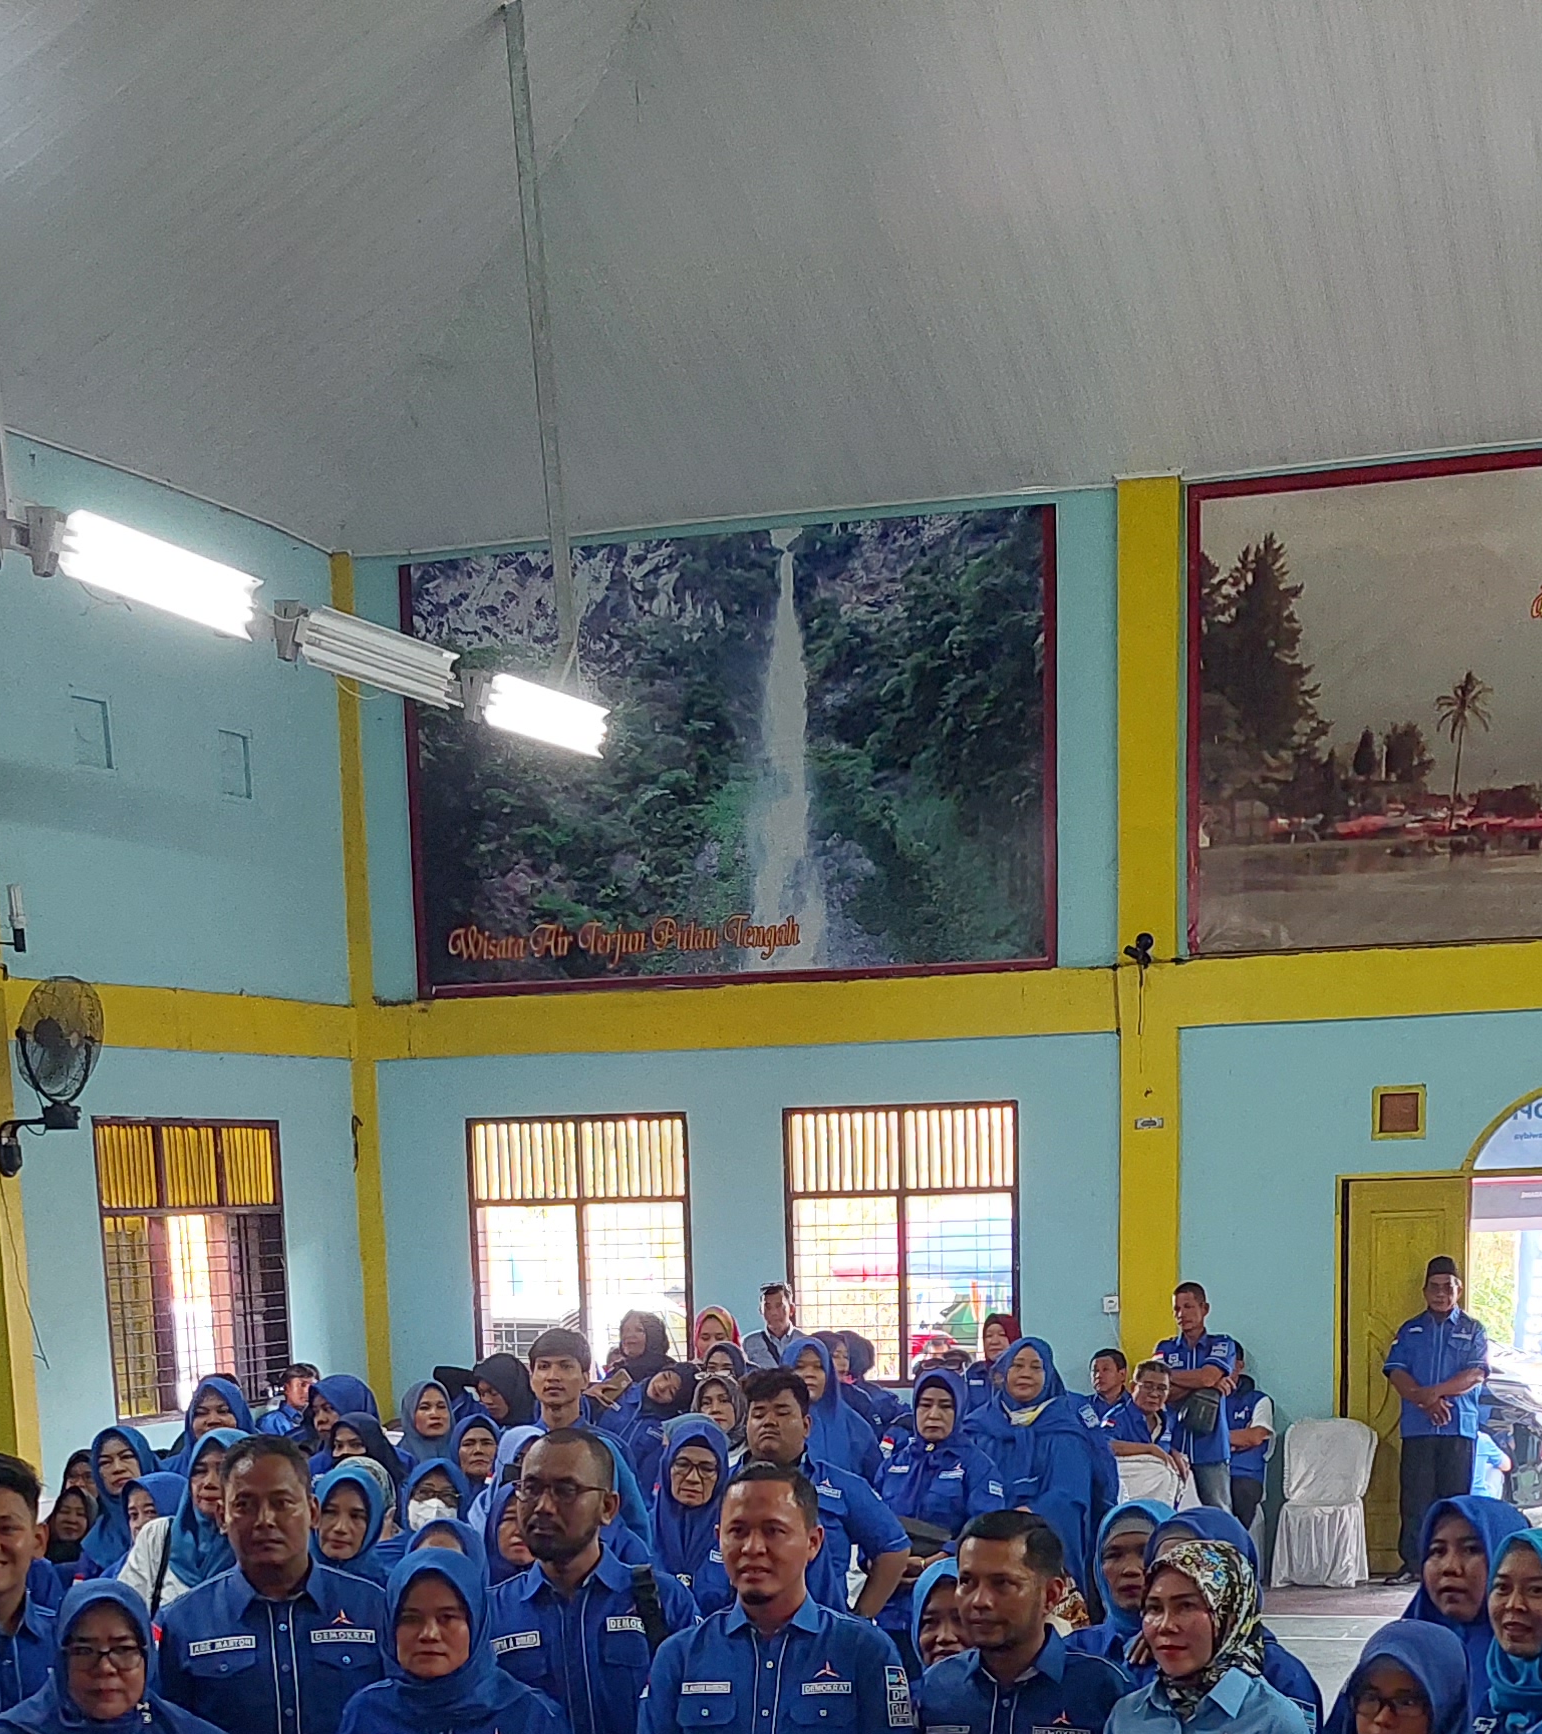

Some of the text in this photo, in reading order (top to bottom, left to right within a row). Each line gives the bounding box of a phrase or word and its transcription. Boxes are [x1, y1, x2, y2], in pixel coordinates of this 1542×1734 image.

[447, 912, 801, 969] Wisata Air Terjun Pulau Tengah
[609, 1618, 645, 1631] DEMOK
[314, 1631, 372, 1641] DEMOKRAT
[804, 1683, 850, 1694] DEMOKRAT
